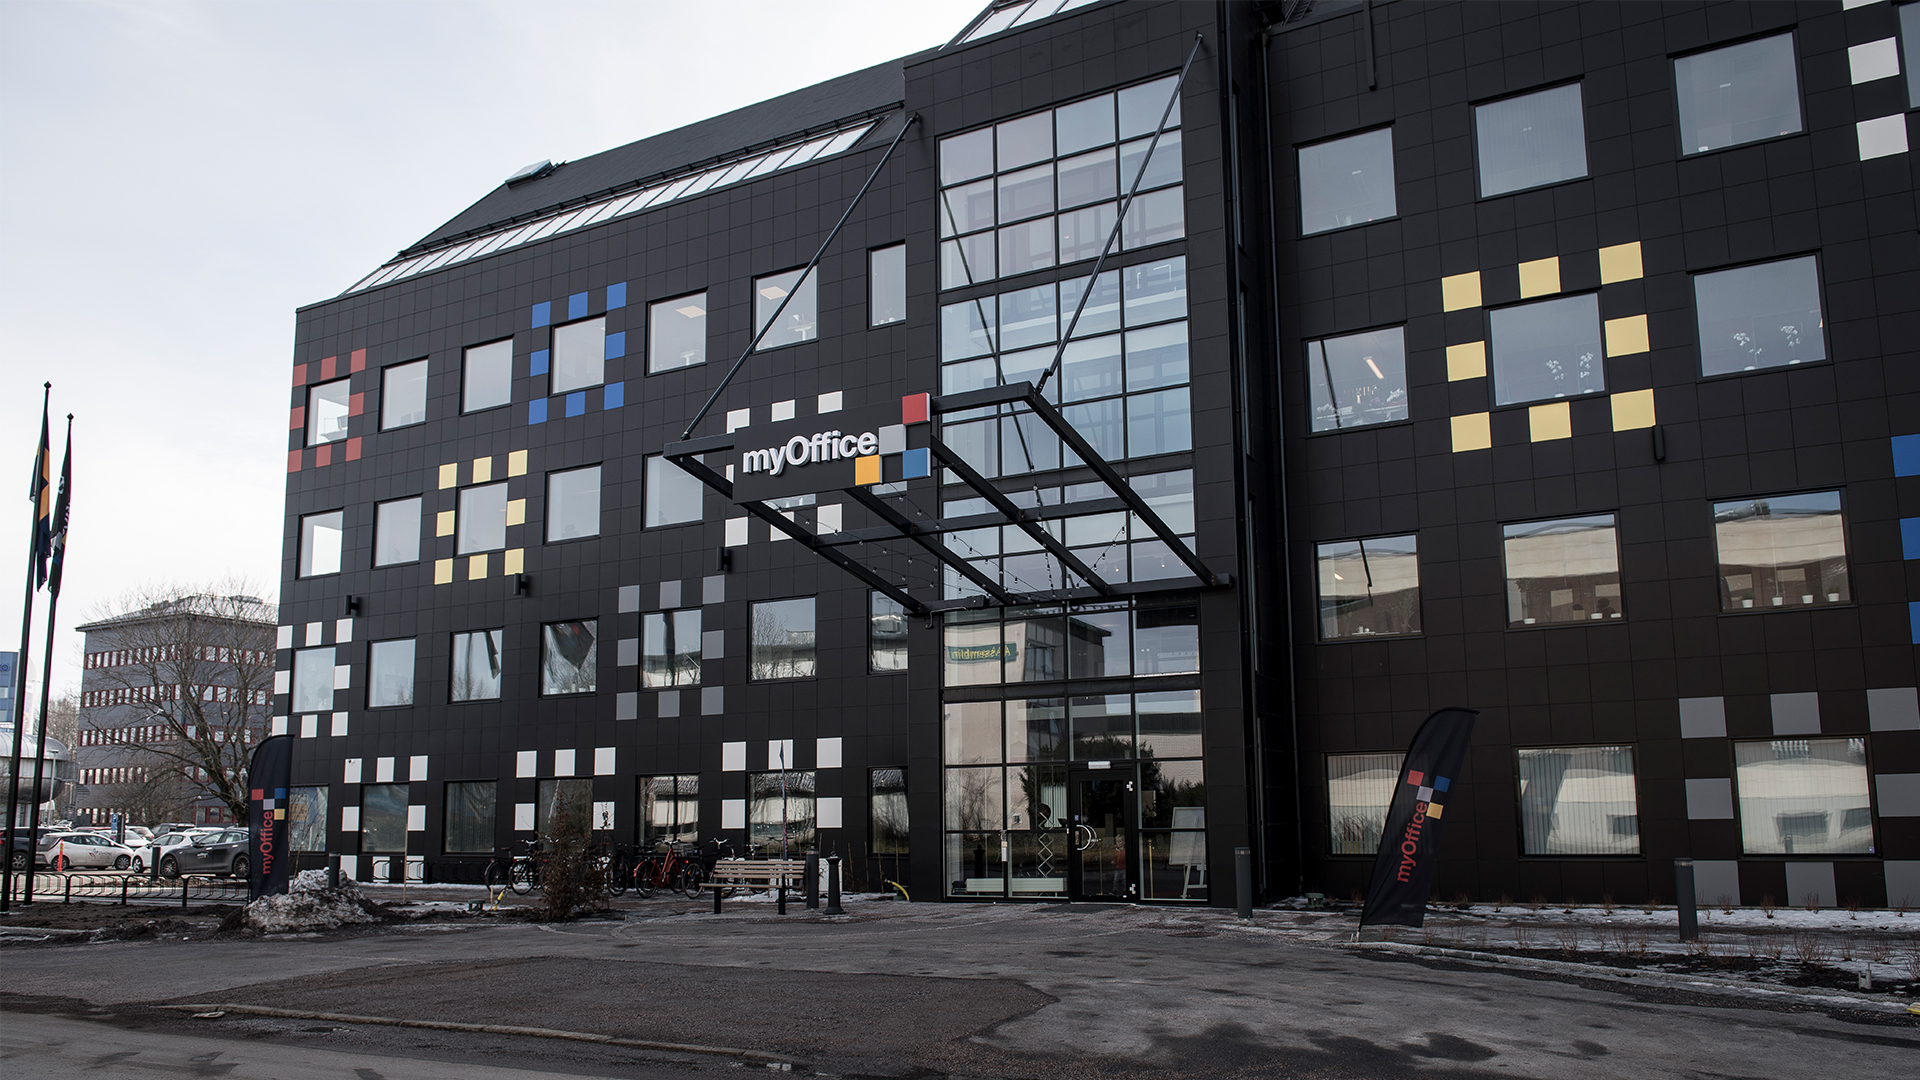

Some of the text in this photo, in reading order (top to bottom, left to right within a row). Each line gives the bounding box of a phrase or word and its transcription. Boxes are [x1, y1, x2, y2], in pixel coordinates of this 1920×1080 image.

[743, 430, 878, 477] myOffice
[259, 811, 274, 875] myOffice
[1397, 802, 1428, 883] myOffice
